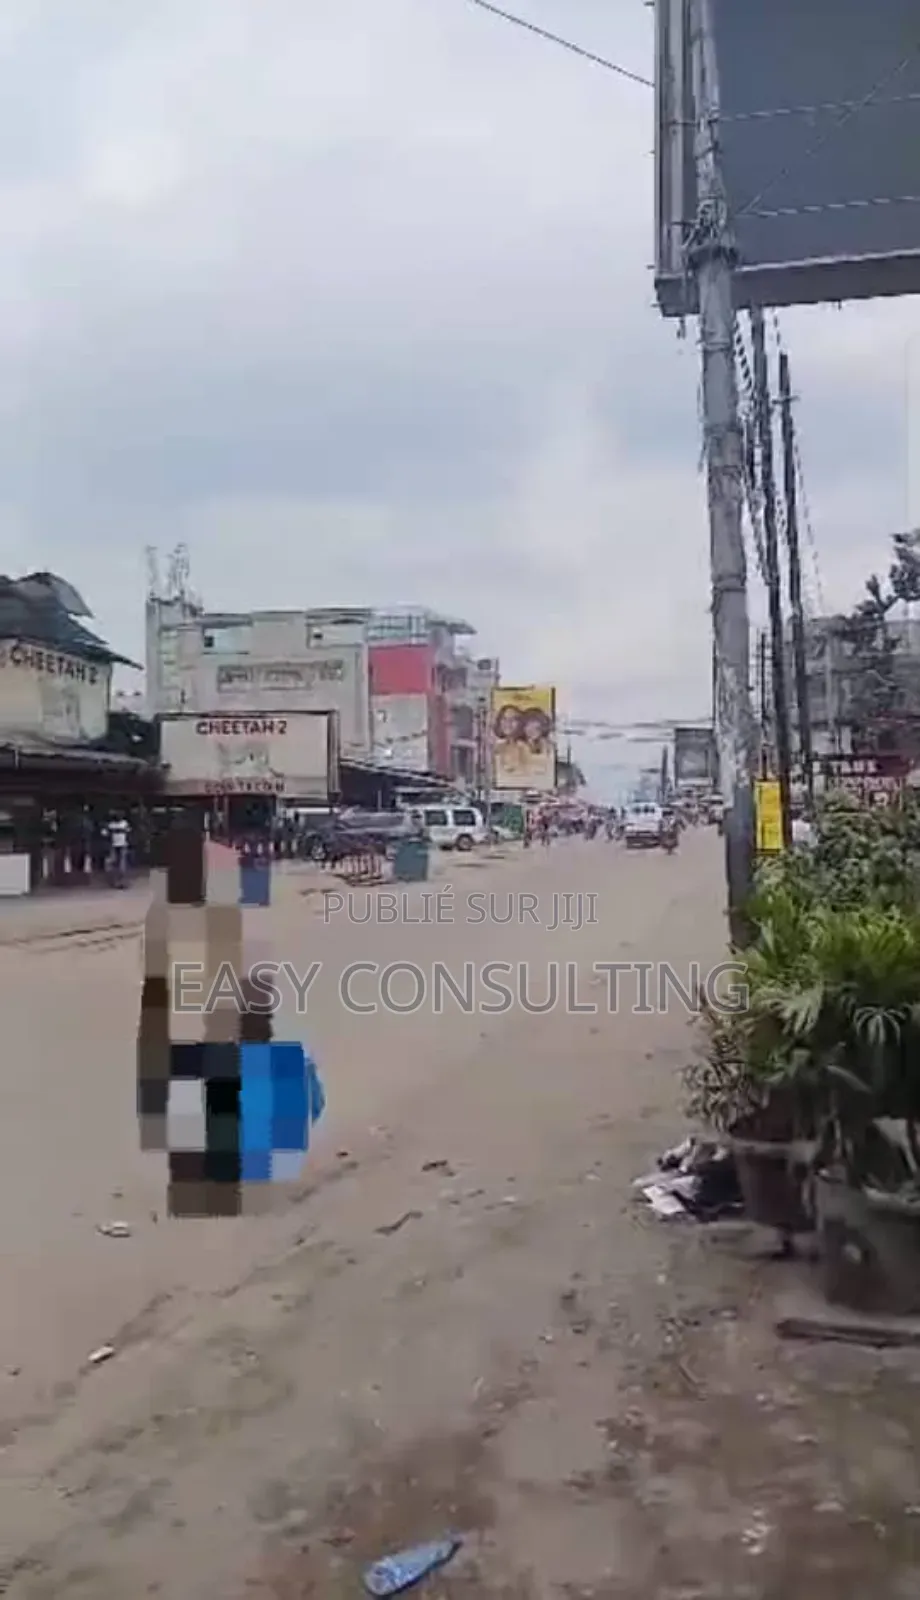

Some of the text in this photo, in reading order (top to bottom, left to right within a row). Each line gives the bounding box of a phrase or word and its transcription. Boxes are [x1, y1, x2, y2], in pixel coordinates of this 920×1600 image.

[10, 645, 86, 682] CHEETAH
[196, 720, 288, 735] CHEETAH 2
